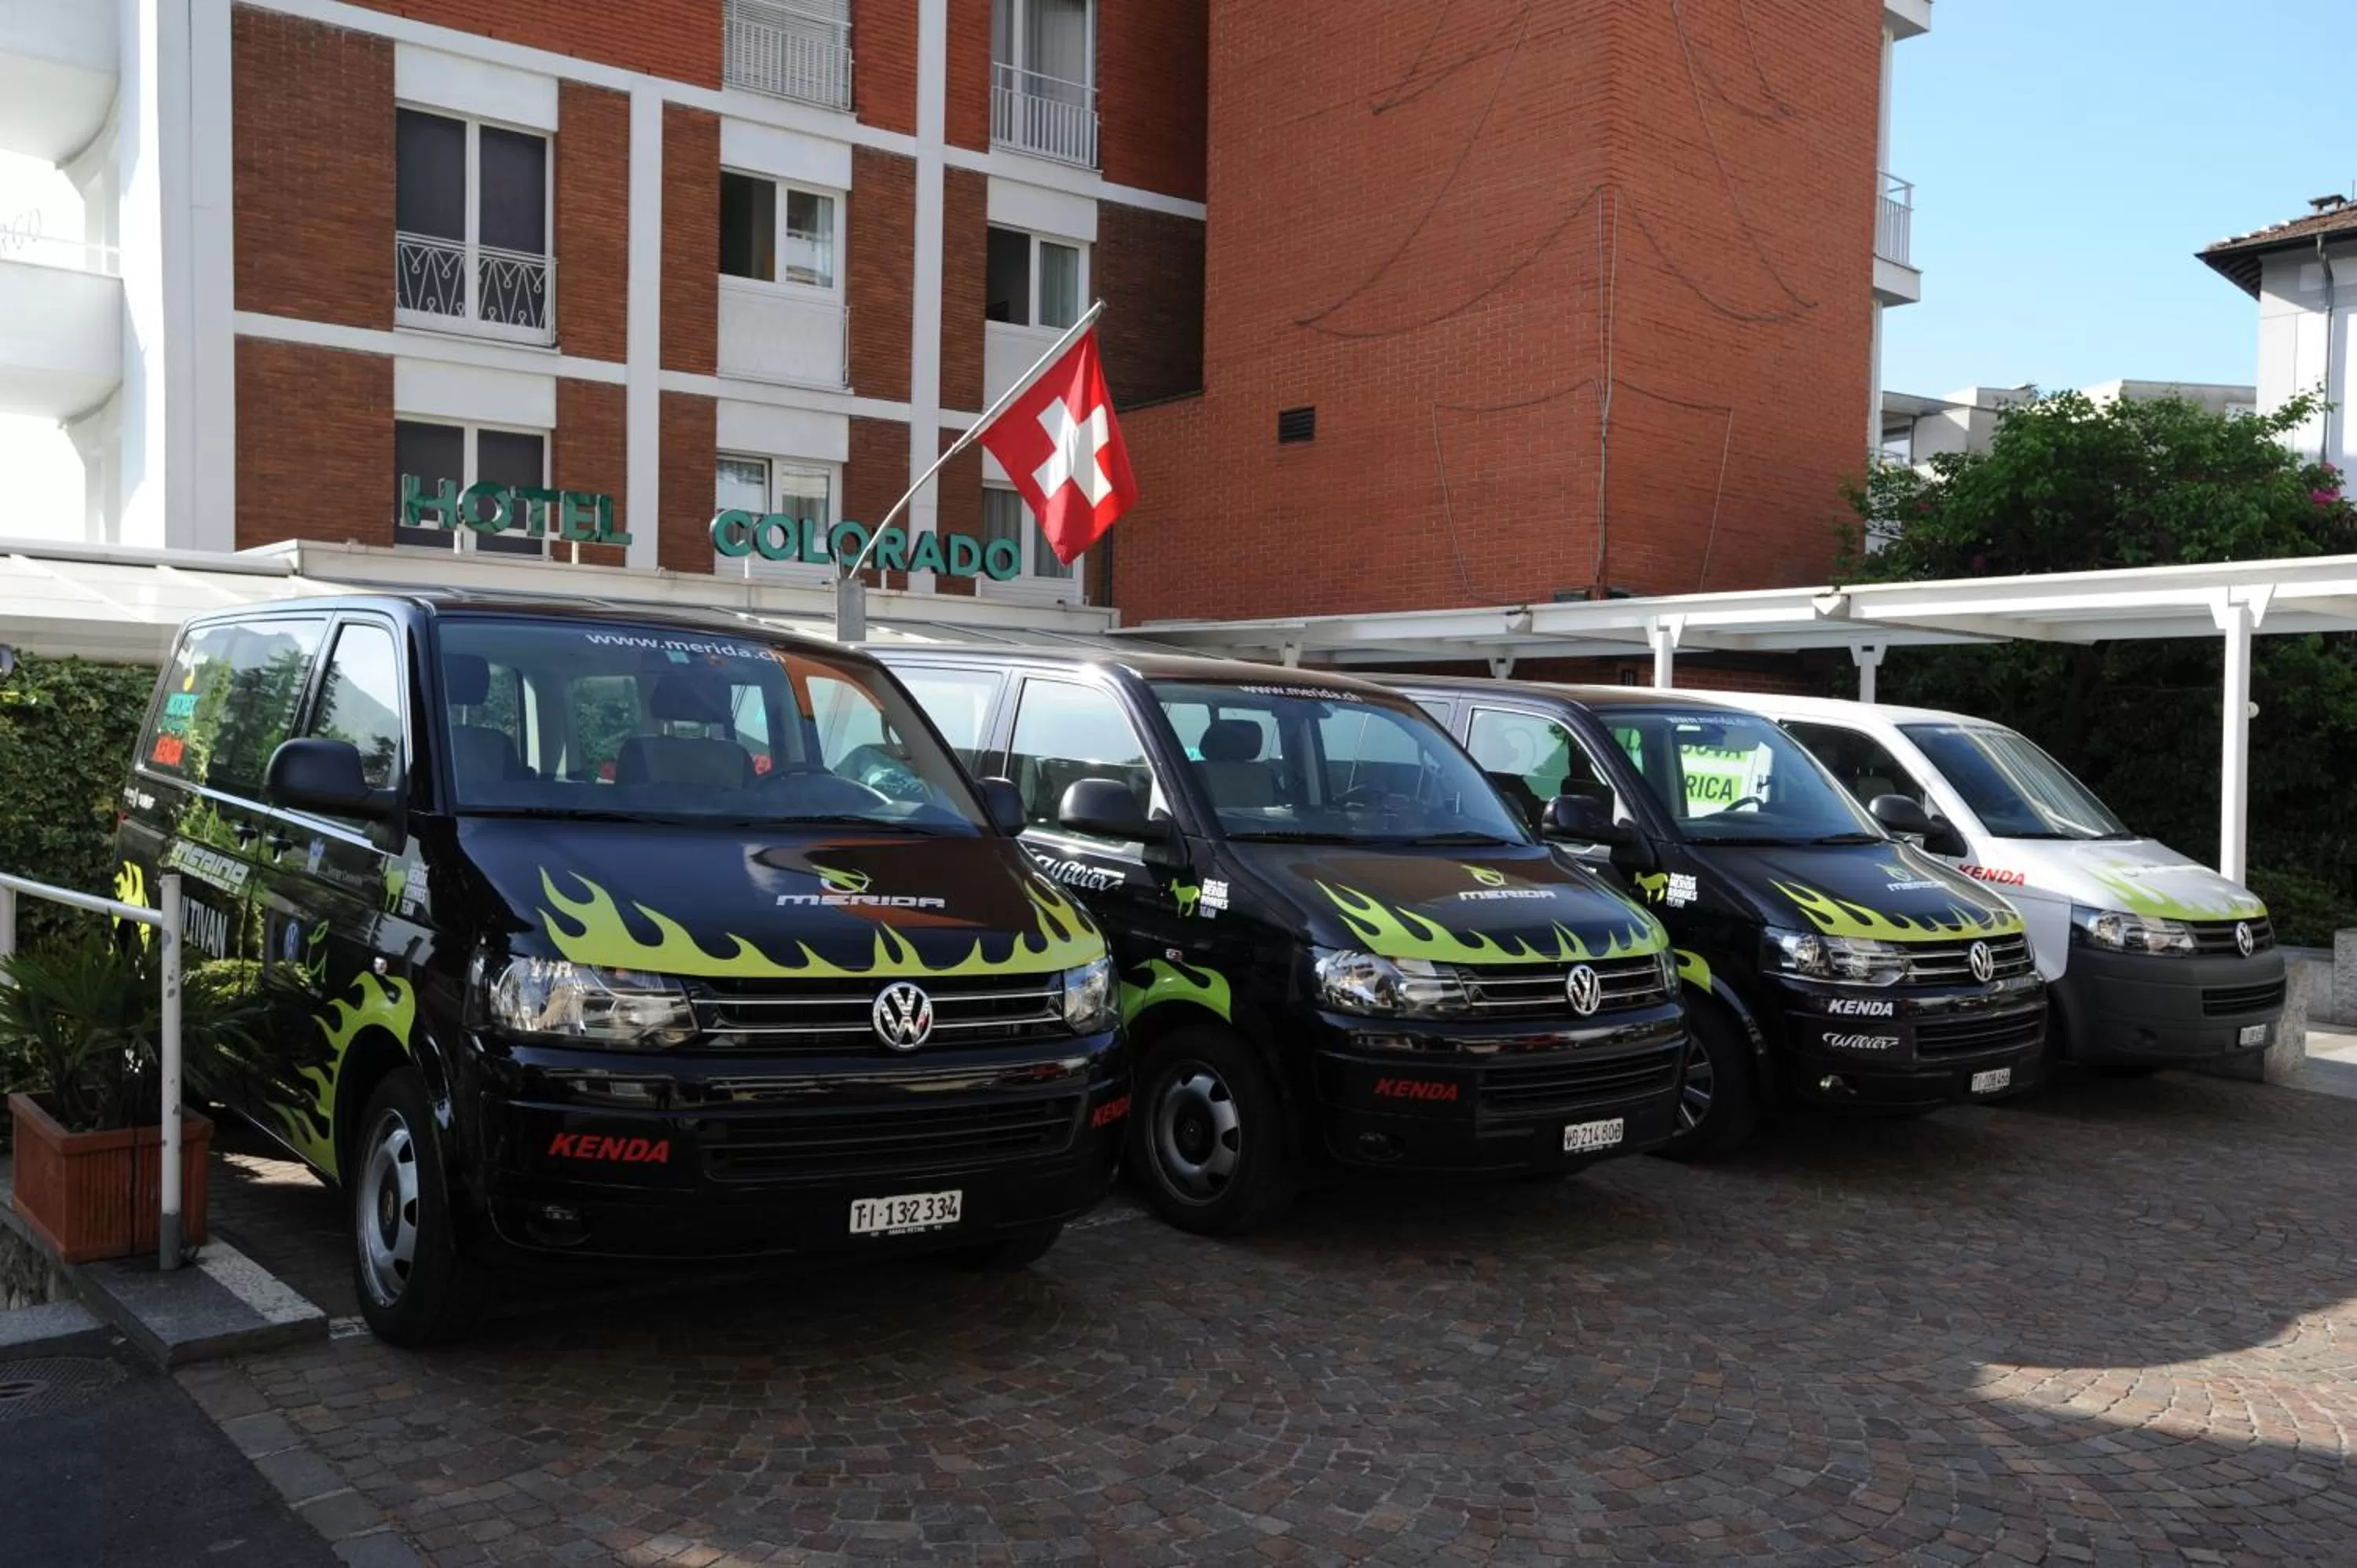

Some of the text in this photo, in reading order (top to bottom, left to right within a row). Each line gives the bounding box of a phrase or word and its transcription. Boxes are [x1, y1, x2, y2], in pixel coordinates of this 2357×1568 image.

[401, 473, 1021, 581] HOTEL COLORADO
[586, 634, 786, 664] www.merida.ch
[775, 894, 945, 907] MERIDA
[1458, 890, 1556, 901] MERIDA
[1828, 998, 1894, 1017] KENDA
[1373, 1079, 1457, 1099] KENDA
[548, 1134, 669, 1163] KENDA
